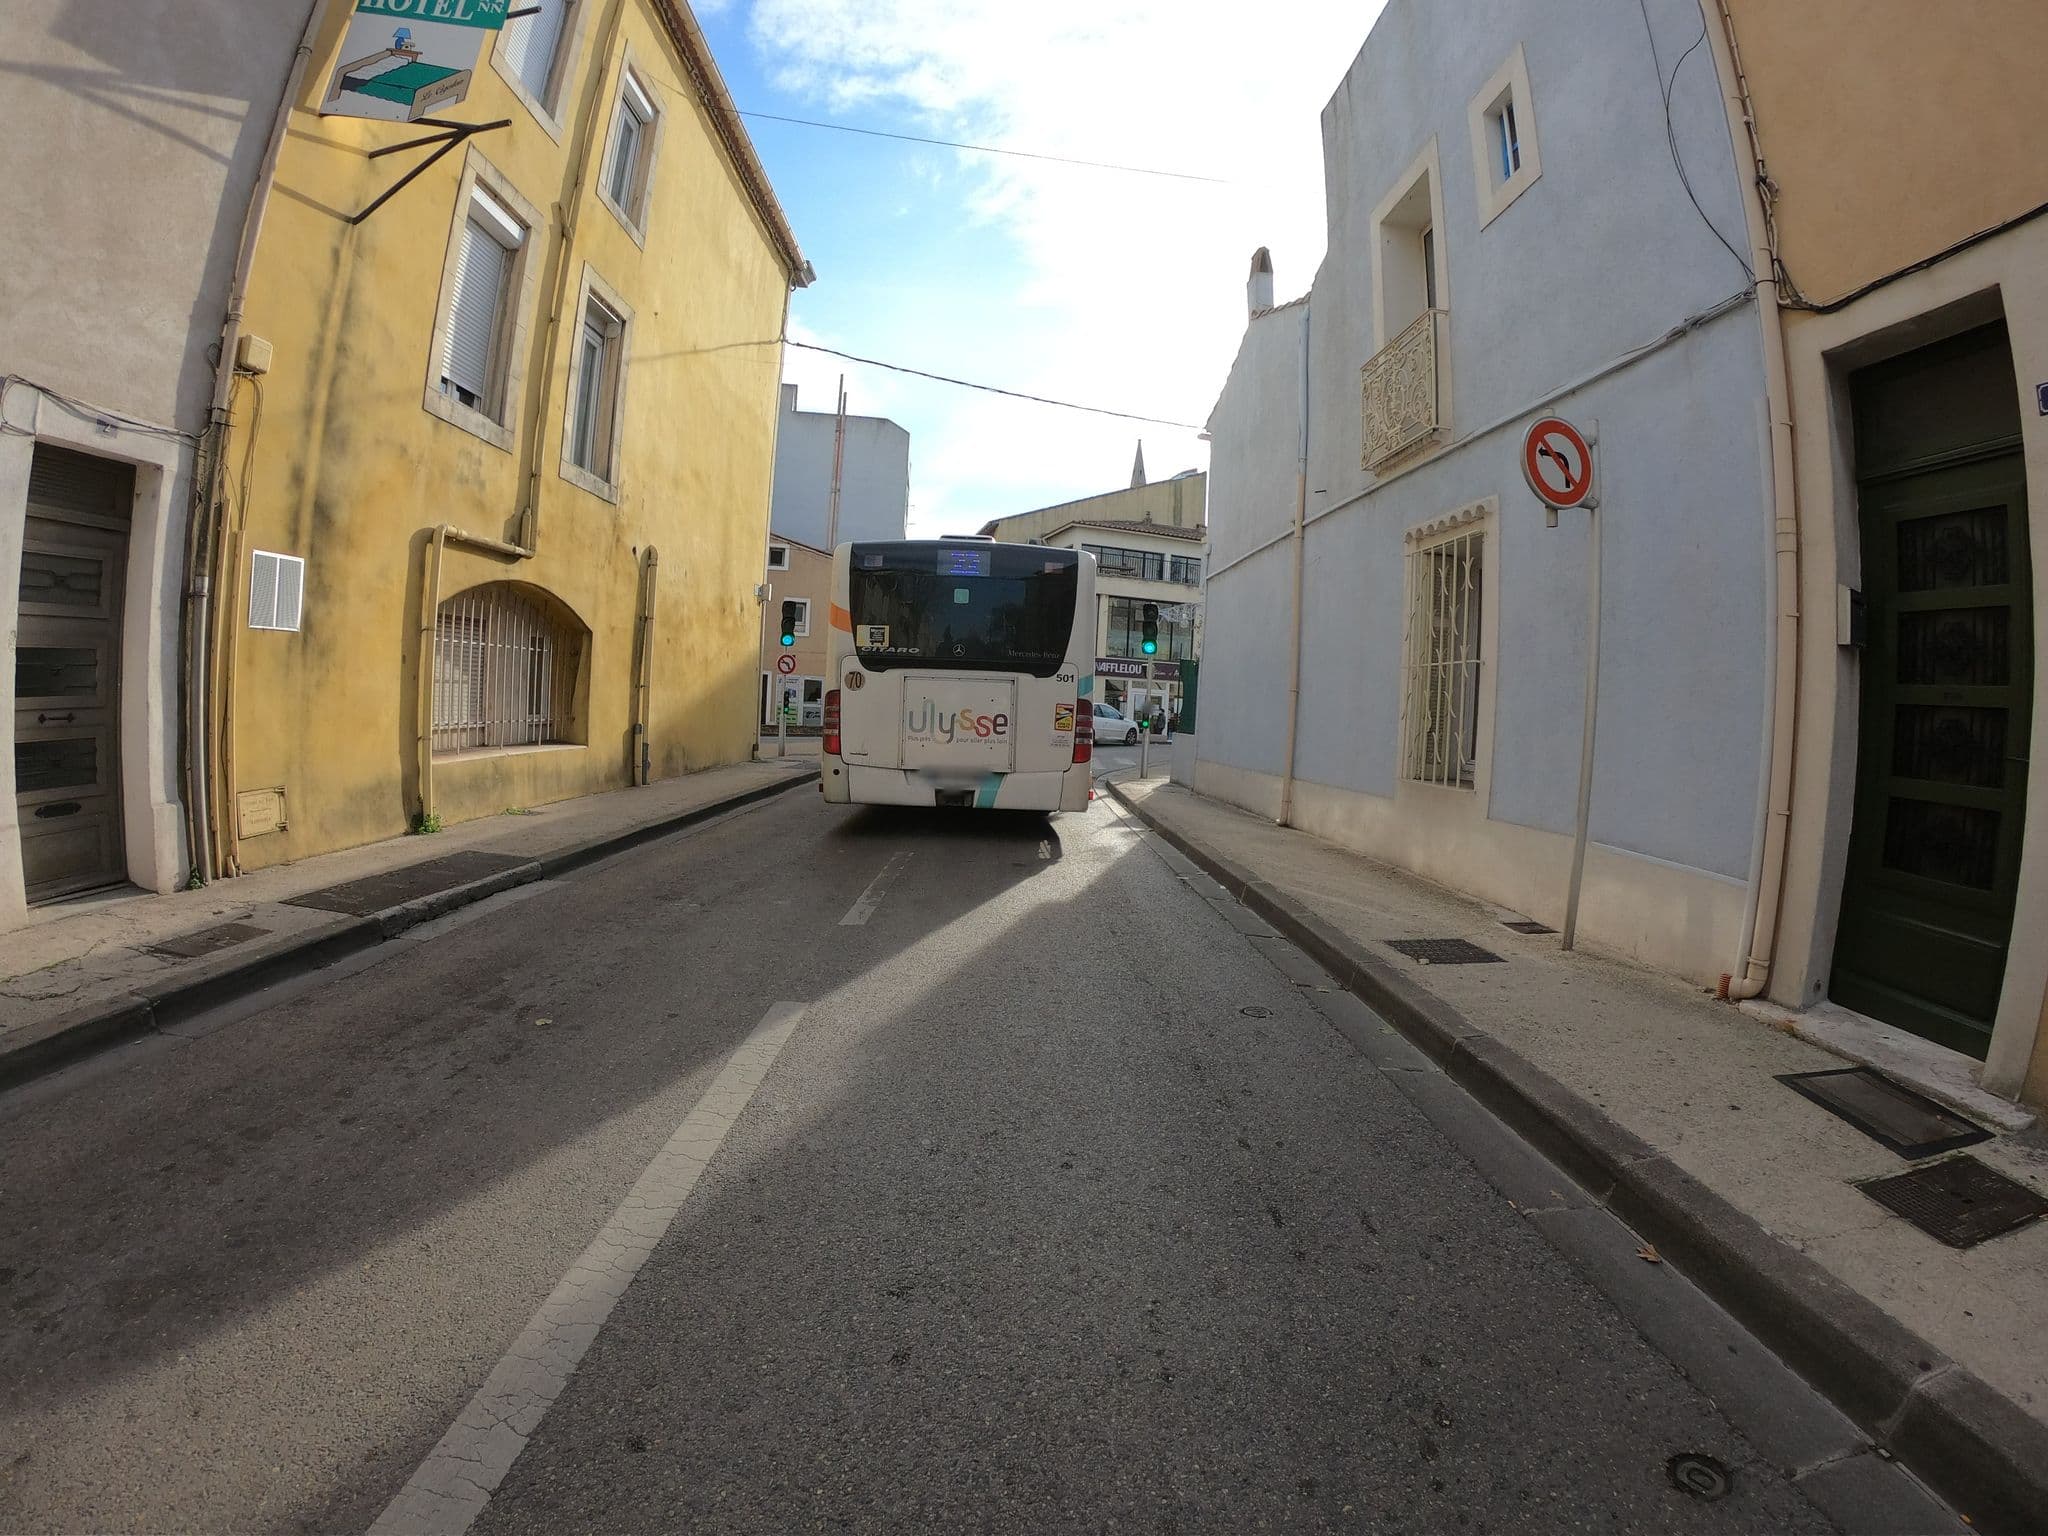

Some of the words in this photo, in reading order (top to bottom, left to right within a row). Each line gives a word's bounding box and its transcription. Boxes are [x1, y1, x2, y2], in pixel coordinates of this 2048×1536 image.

[849, 672, 862, 688] 70
[1056, 674, 1074, 682] 501
[909, 699, 1009, 744] ulysse
